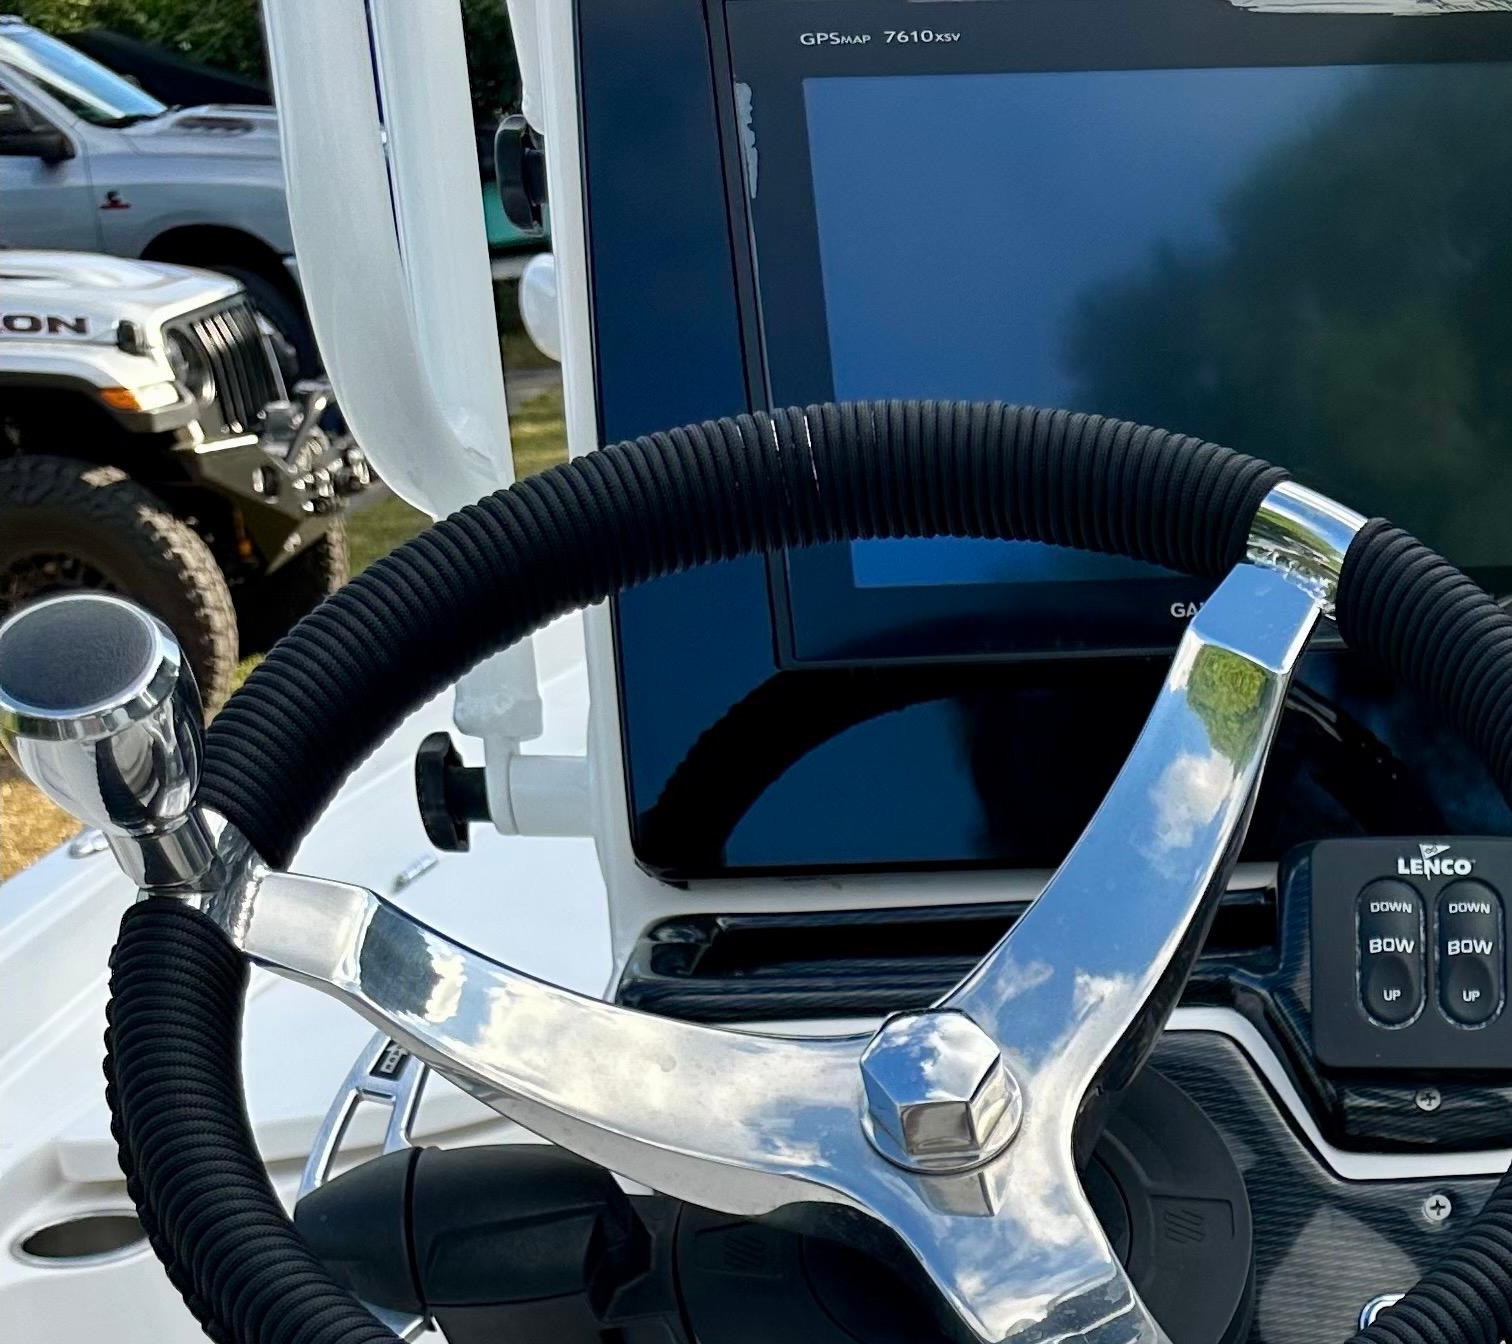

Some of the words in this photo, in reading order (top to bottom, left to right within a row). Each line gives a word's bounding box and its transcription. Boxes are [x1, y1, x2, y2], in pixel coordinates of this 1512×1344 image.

[1, 314, 88, 334] ON
[1397, 855, 1473, 880] LENCO
[1370, 901, 1413, 914] DOWN
[1448, 902, 1491, 915] DOWN
[1369, 937, 1415, 954] BOW
[1447, 939, 1493, 956] BOW
[1383, 989, 1402, 1002] UP
[1462, 989, 1481, 1002] UP
